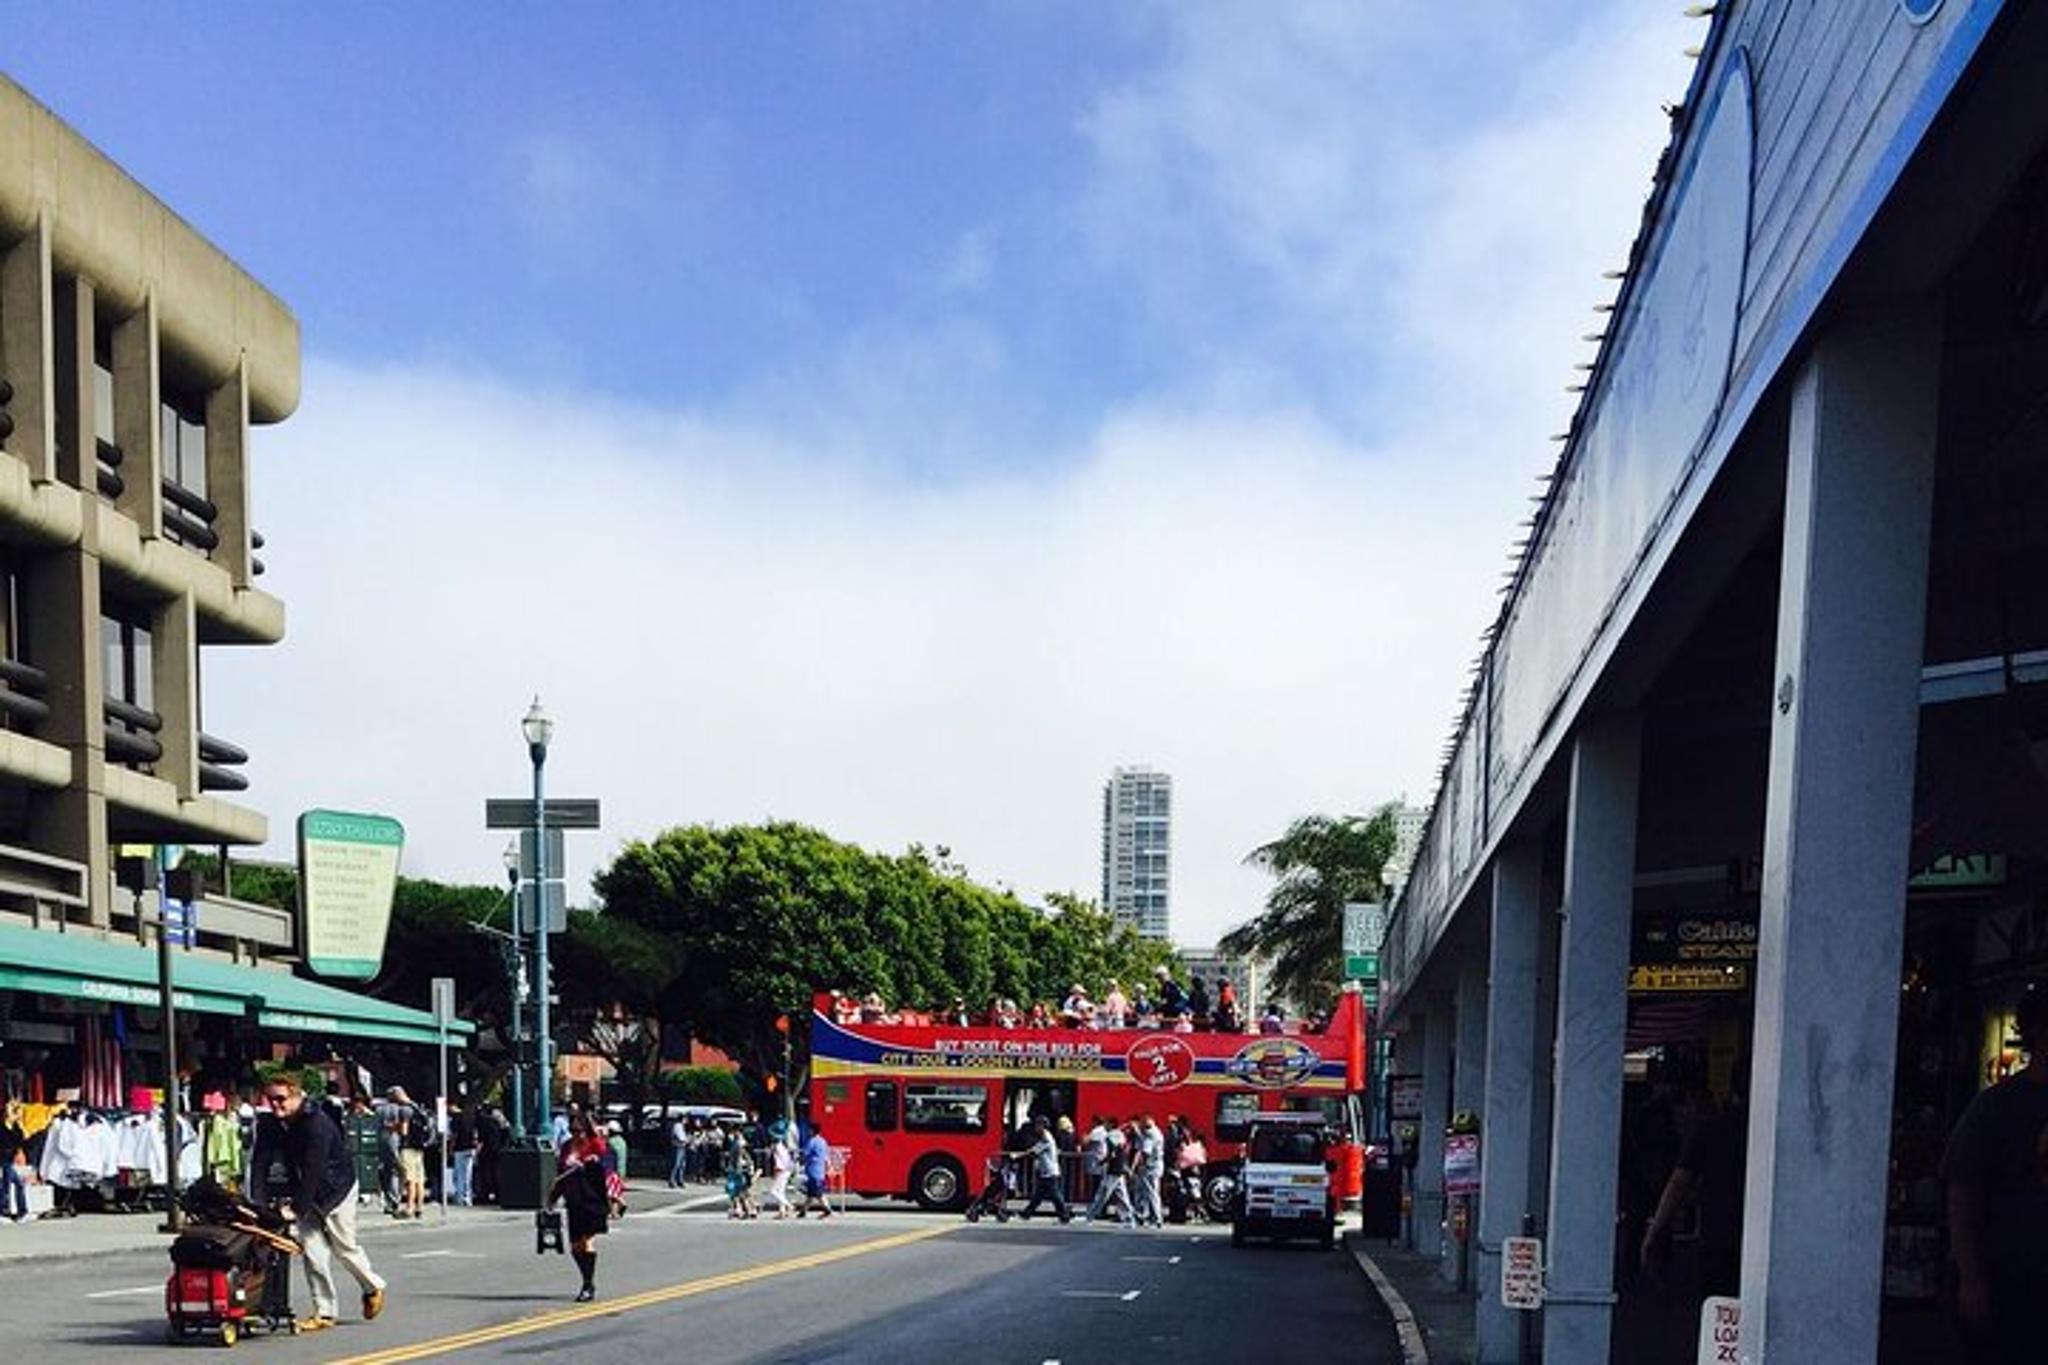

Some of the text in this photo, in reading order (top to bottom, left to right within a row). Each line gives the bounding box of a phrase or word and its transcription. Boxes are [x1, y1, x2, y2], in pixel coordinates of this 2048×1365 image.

[935, 1040, 1101, 1056] BUY TICKET ON THE BUS FOR
[881, 1053, 1101, 1070] CITY TOUR GOLDEN GATE BRIDGE
[1152, 1057, 1168, 1073] 2
